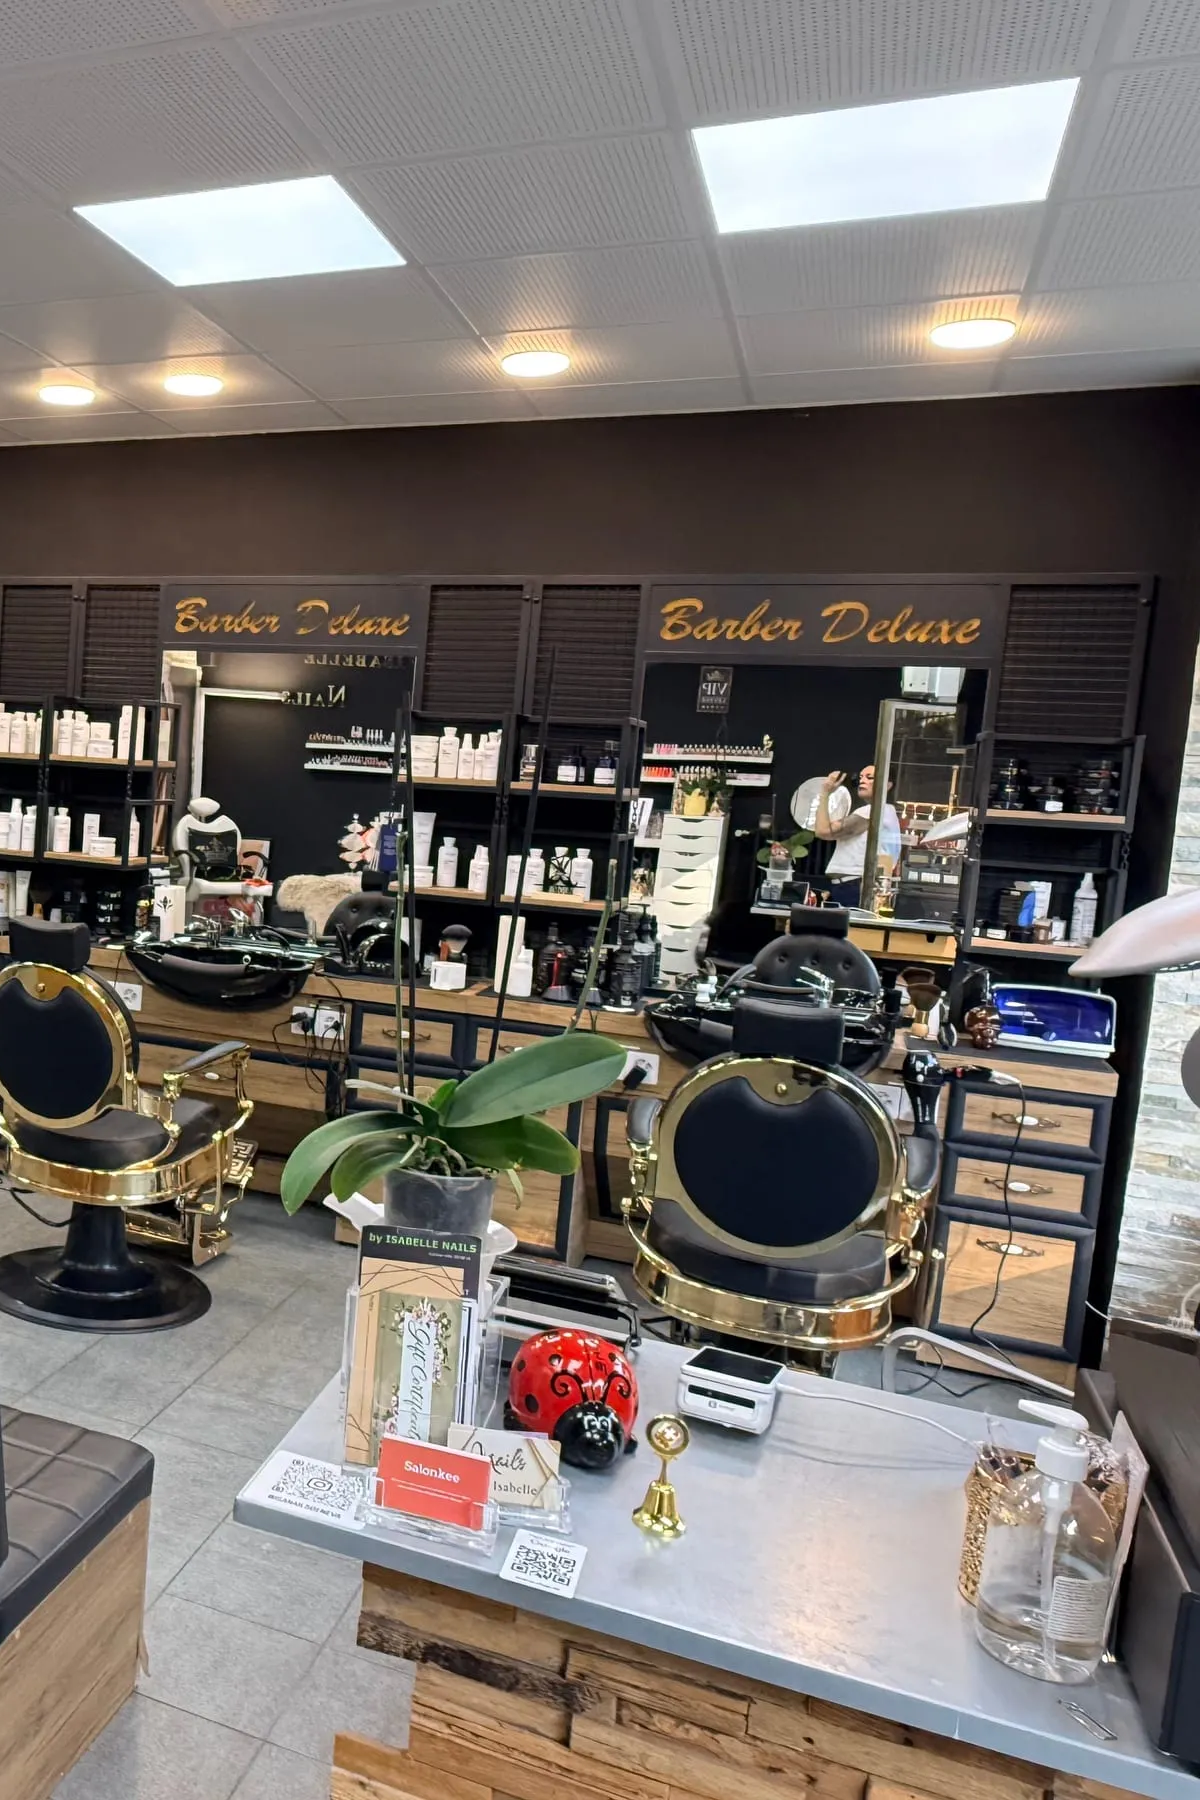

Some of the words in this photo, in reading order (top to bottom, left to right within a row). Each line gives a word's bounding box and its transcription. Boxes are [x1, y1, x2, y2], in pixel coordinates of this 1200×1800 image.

[175, 597, 280, 633] Barber
[296, 600, 410, 636] Deluxe
[660, 598, 803, 641] Barber
[821, 601, 981, 644] Deluxe
[369, 1232, 383, 1245] by
[385, 1234, 439, 1249] ISABELLE
[442, 1241, 477, 1253] NAILS
[403, 1365, 428, 1441] Certificat
[404, 1460, 461, 1484] Salonkee
[493, 1479, 539, 1496] Isabelle
